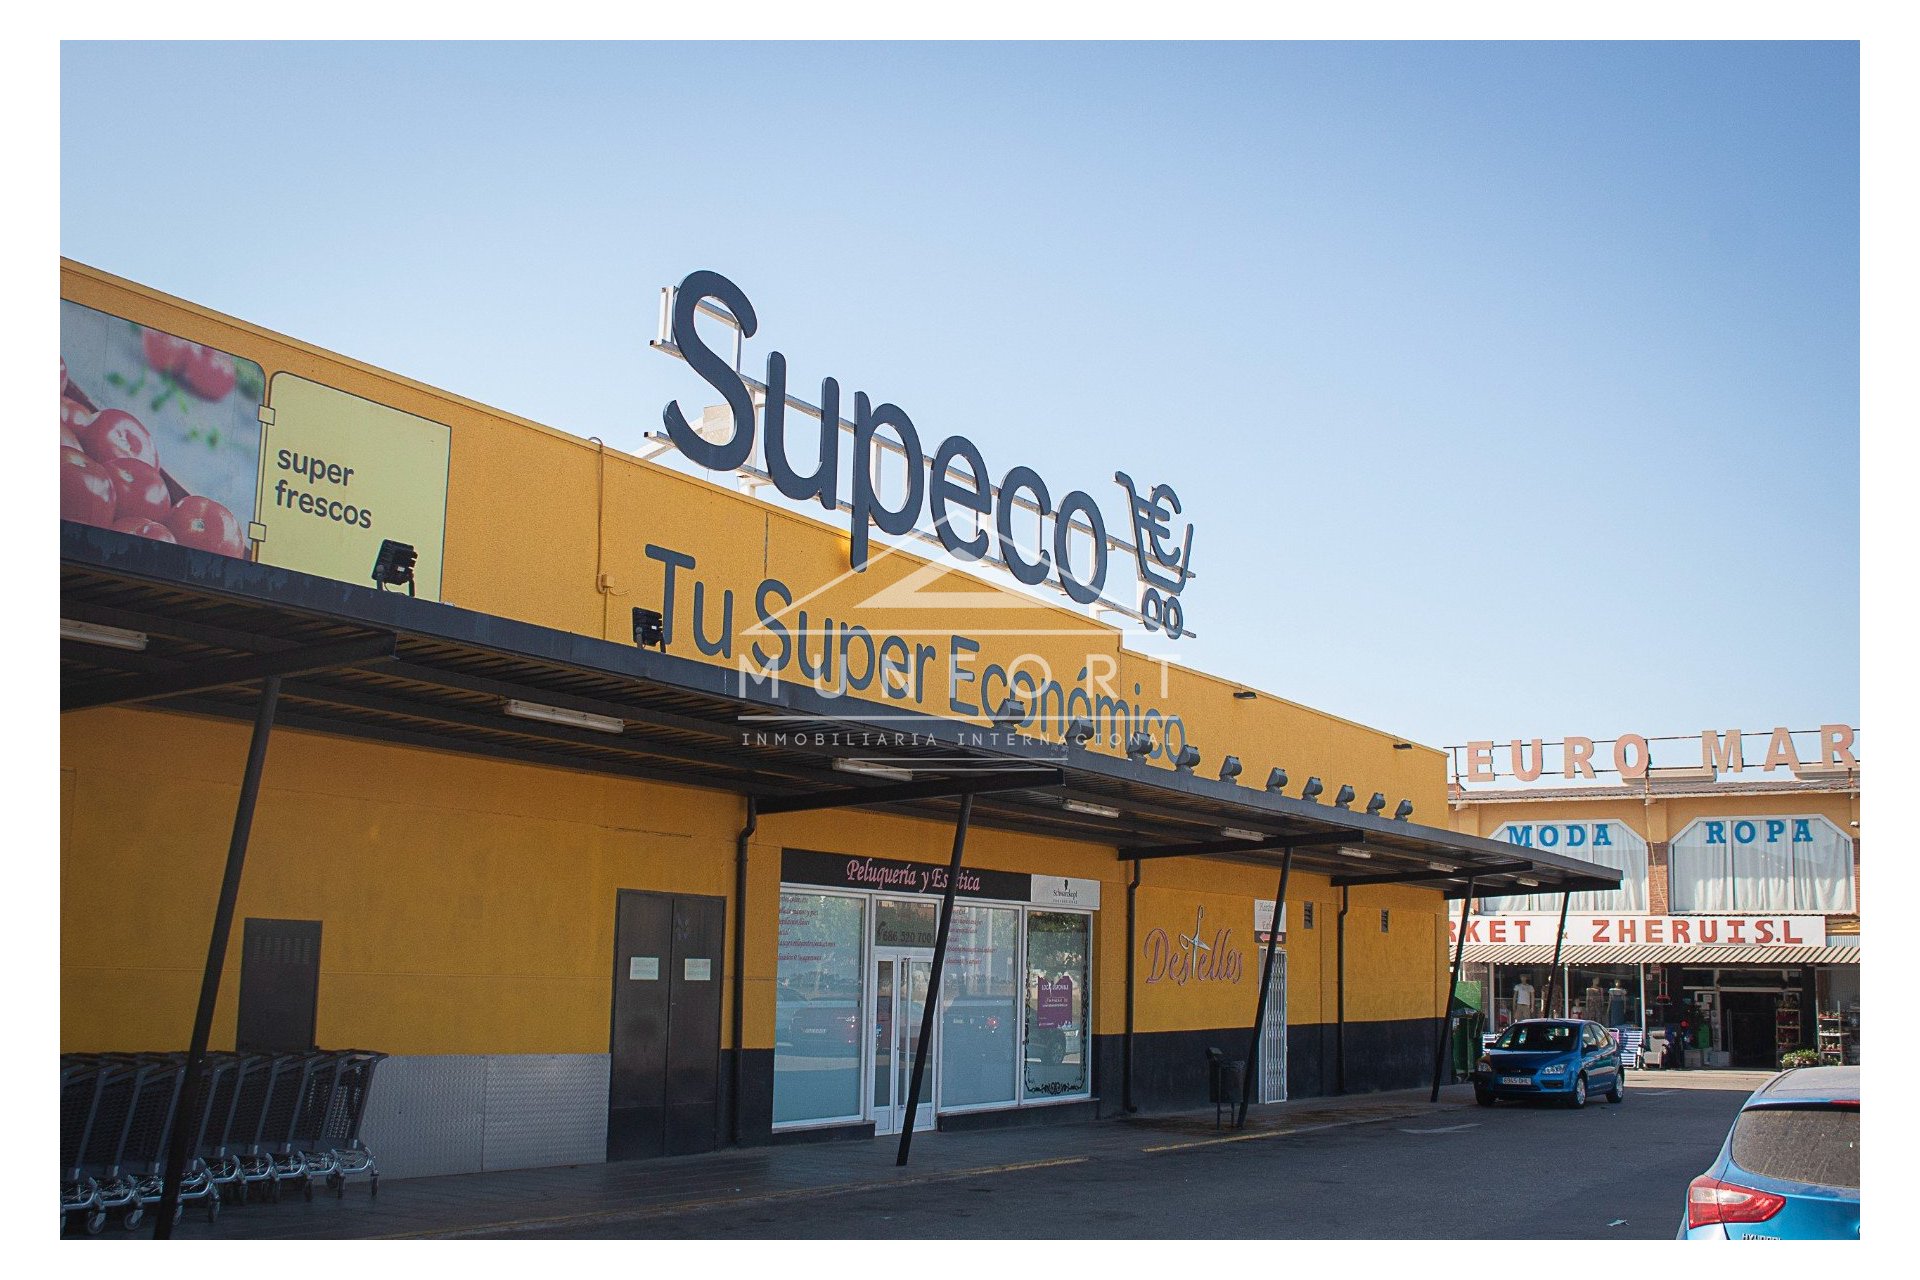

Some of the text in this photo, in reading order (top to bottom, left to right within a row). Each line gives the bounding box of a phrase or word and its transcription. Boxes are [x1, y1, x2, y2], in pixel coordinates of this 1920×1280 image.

[663, 270, 1107, 604] Supeco
[277, 450, 354, 486] super
[275, 479, 372, 529] frescos
[645, 544, 1186, 764] Tu Super Económico
[1467, 724, 1859, 782] EURO MAR
[1507, 824, 1612, 848] MODA
[1706, 819, 1813, 844] ROPA
[846, 858, 980, 893] Peluquería y Estica
[1144, 905, 1243, 986] Destellos
